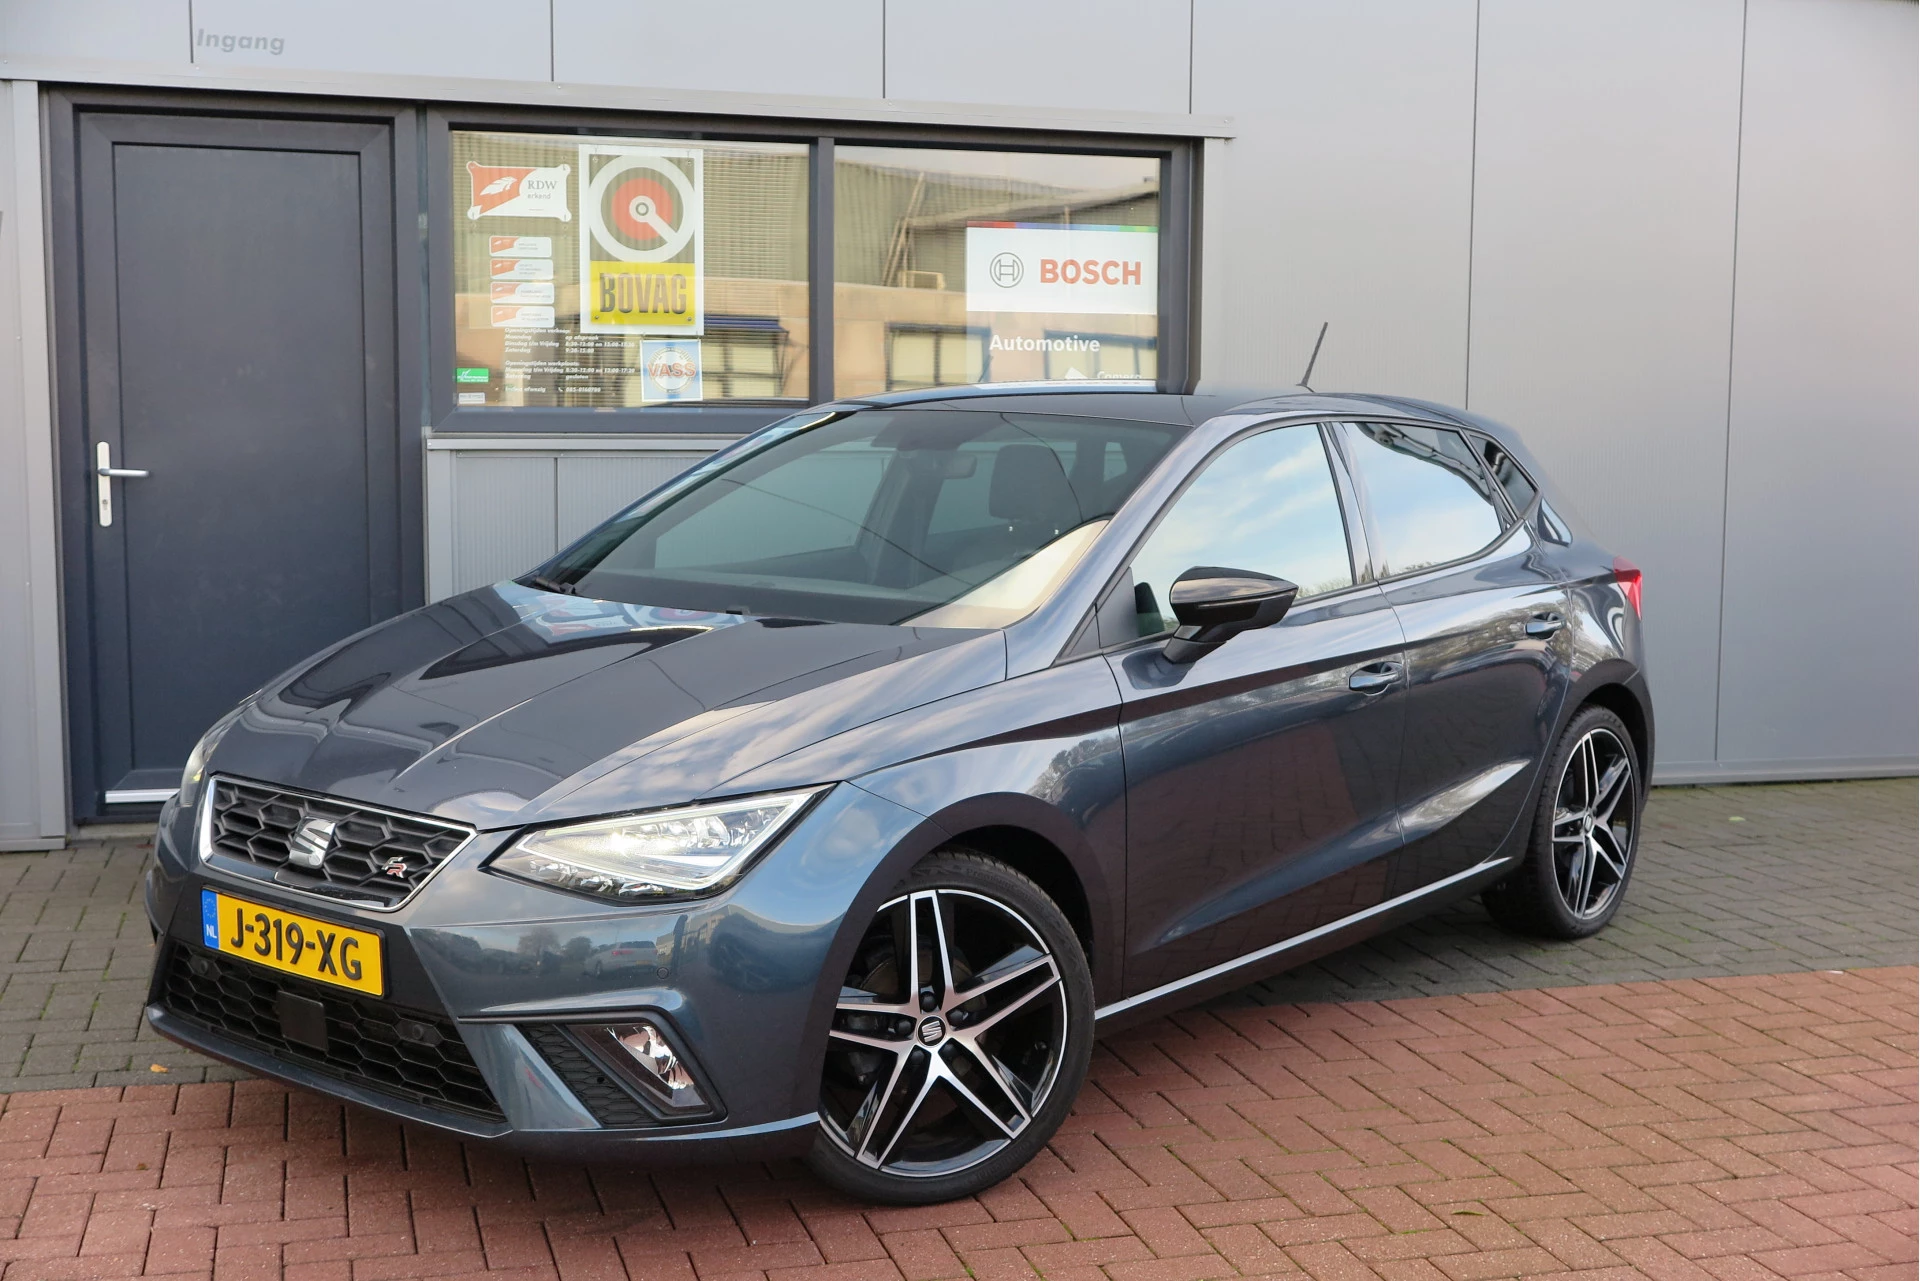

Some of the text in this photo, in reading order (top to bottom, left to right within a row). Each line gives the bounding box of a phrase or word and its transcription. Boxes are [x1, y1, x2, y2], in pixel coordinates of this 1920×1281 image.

[197, 28, 285, 55] Ingang
[527, 180, 557, 190] RDW
[527, 192, 551, 200] erkend
[1040, 258, 1142, 286] BOSCH
[599, 272, 687, 315] BOVAG
[989, 335, 1101, 352] Automotive
[647, 361, 697, 377] VASS
[205, 924, 218, 939] NL
[230, 907, 362, 981] J-319-XG
